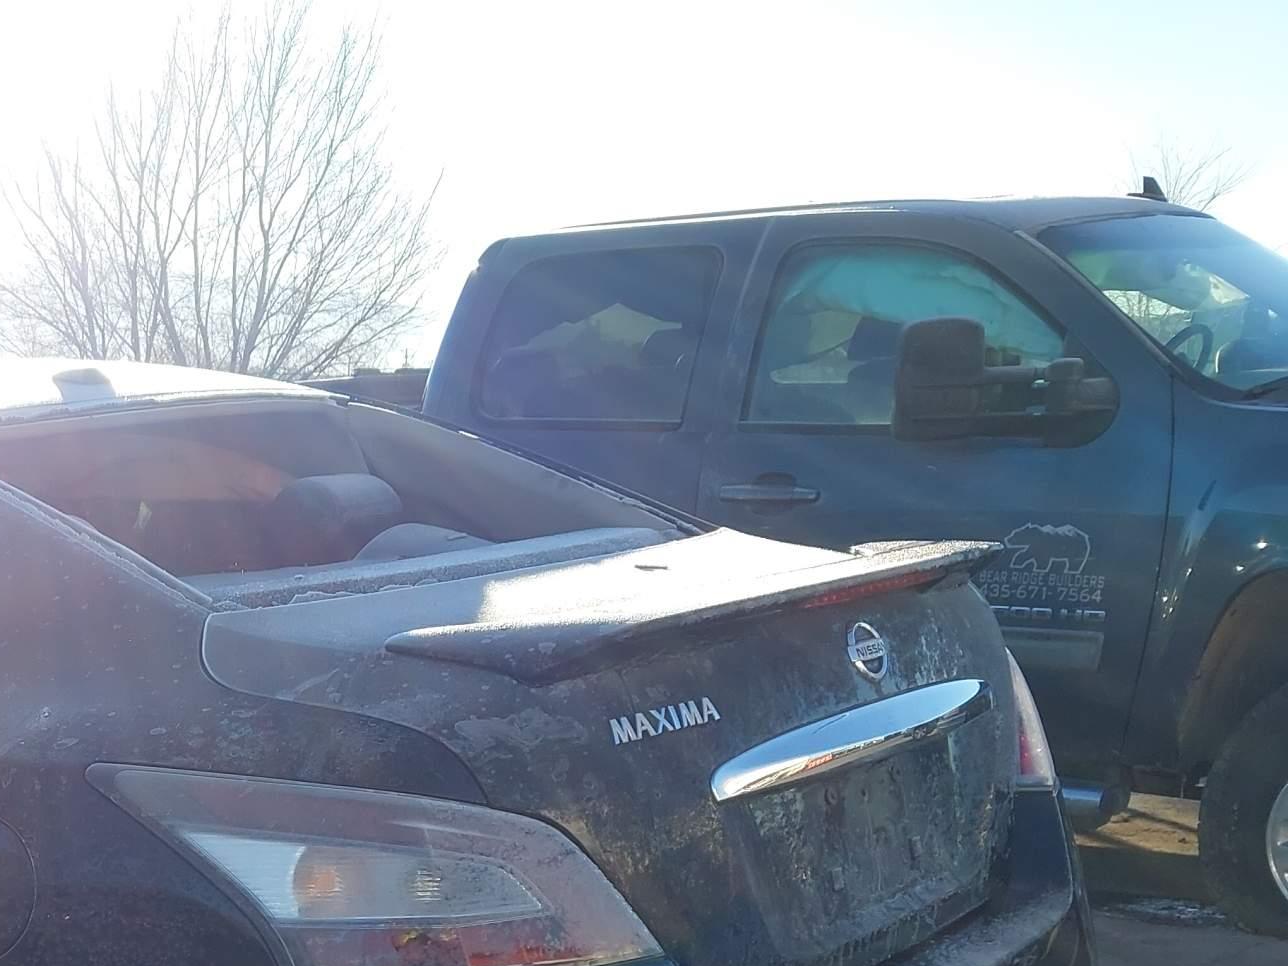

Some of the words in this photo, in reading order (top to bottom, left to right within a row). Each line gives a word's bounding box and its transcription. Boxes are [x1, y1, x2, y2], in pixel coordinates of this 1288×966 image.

[979, 570, 1007, 583] BEAR
[1012, 571, 1045, 586] RIDGE
[1048, 573, 1105, 589] BUILDERS
[609, 696, 721, 745] MAXIMA
